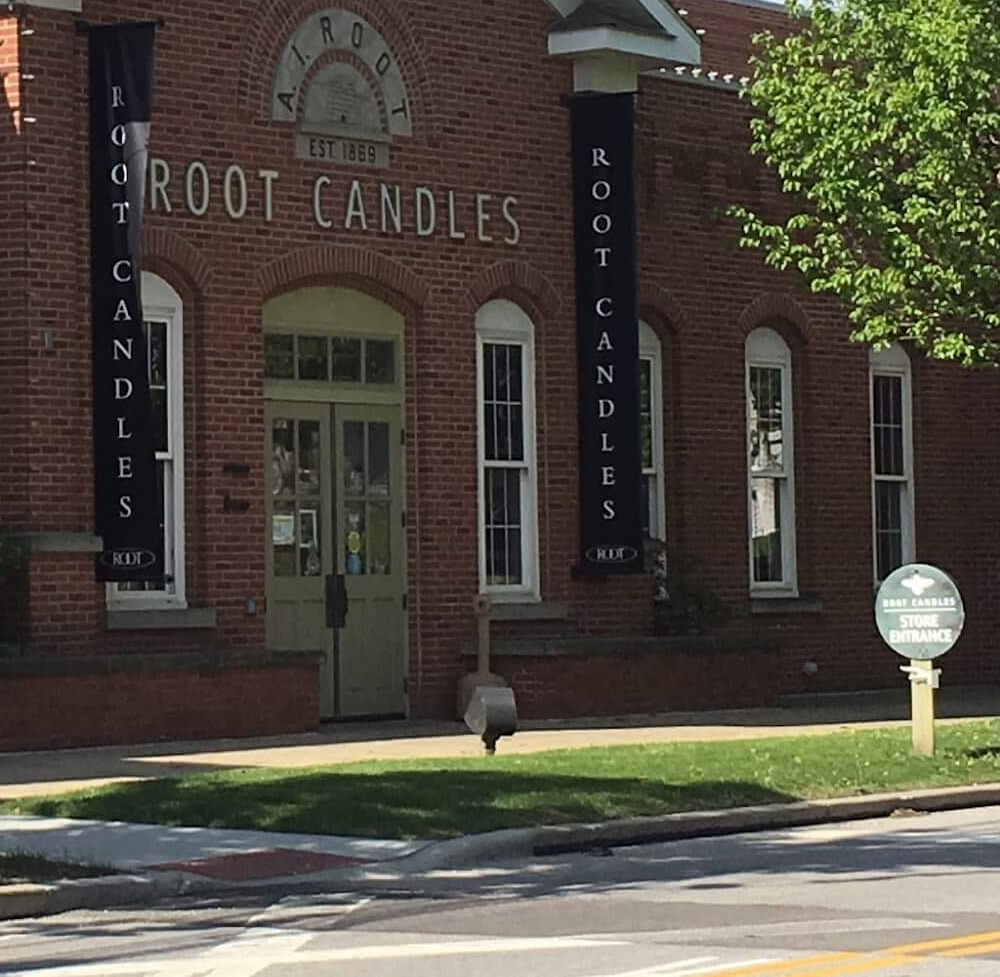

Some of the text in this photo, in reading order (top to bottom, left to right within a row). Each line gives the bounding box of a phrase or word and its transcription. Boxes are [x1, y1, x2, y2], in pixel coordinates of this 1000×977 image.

[320, 16, 408, 119] ROOT
[341, 142, 377, 163] 1869
[151, 158, 521, 245] ROOT CANDLES
[111, 85, 133, 518] ROOT CANDLES
[592, 147, 615, 520] ROOT CANDLES
[112, 551, 144, 565] ROOT
[888, 628, 953, 643] ENTRANCE
[899, 614, 940, 628] STORE
